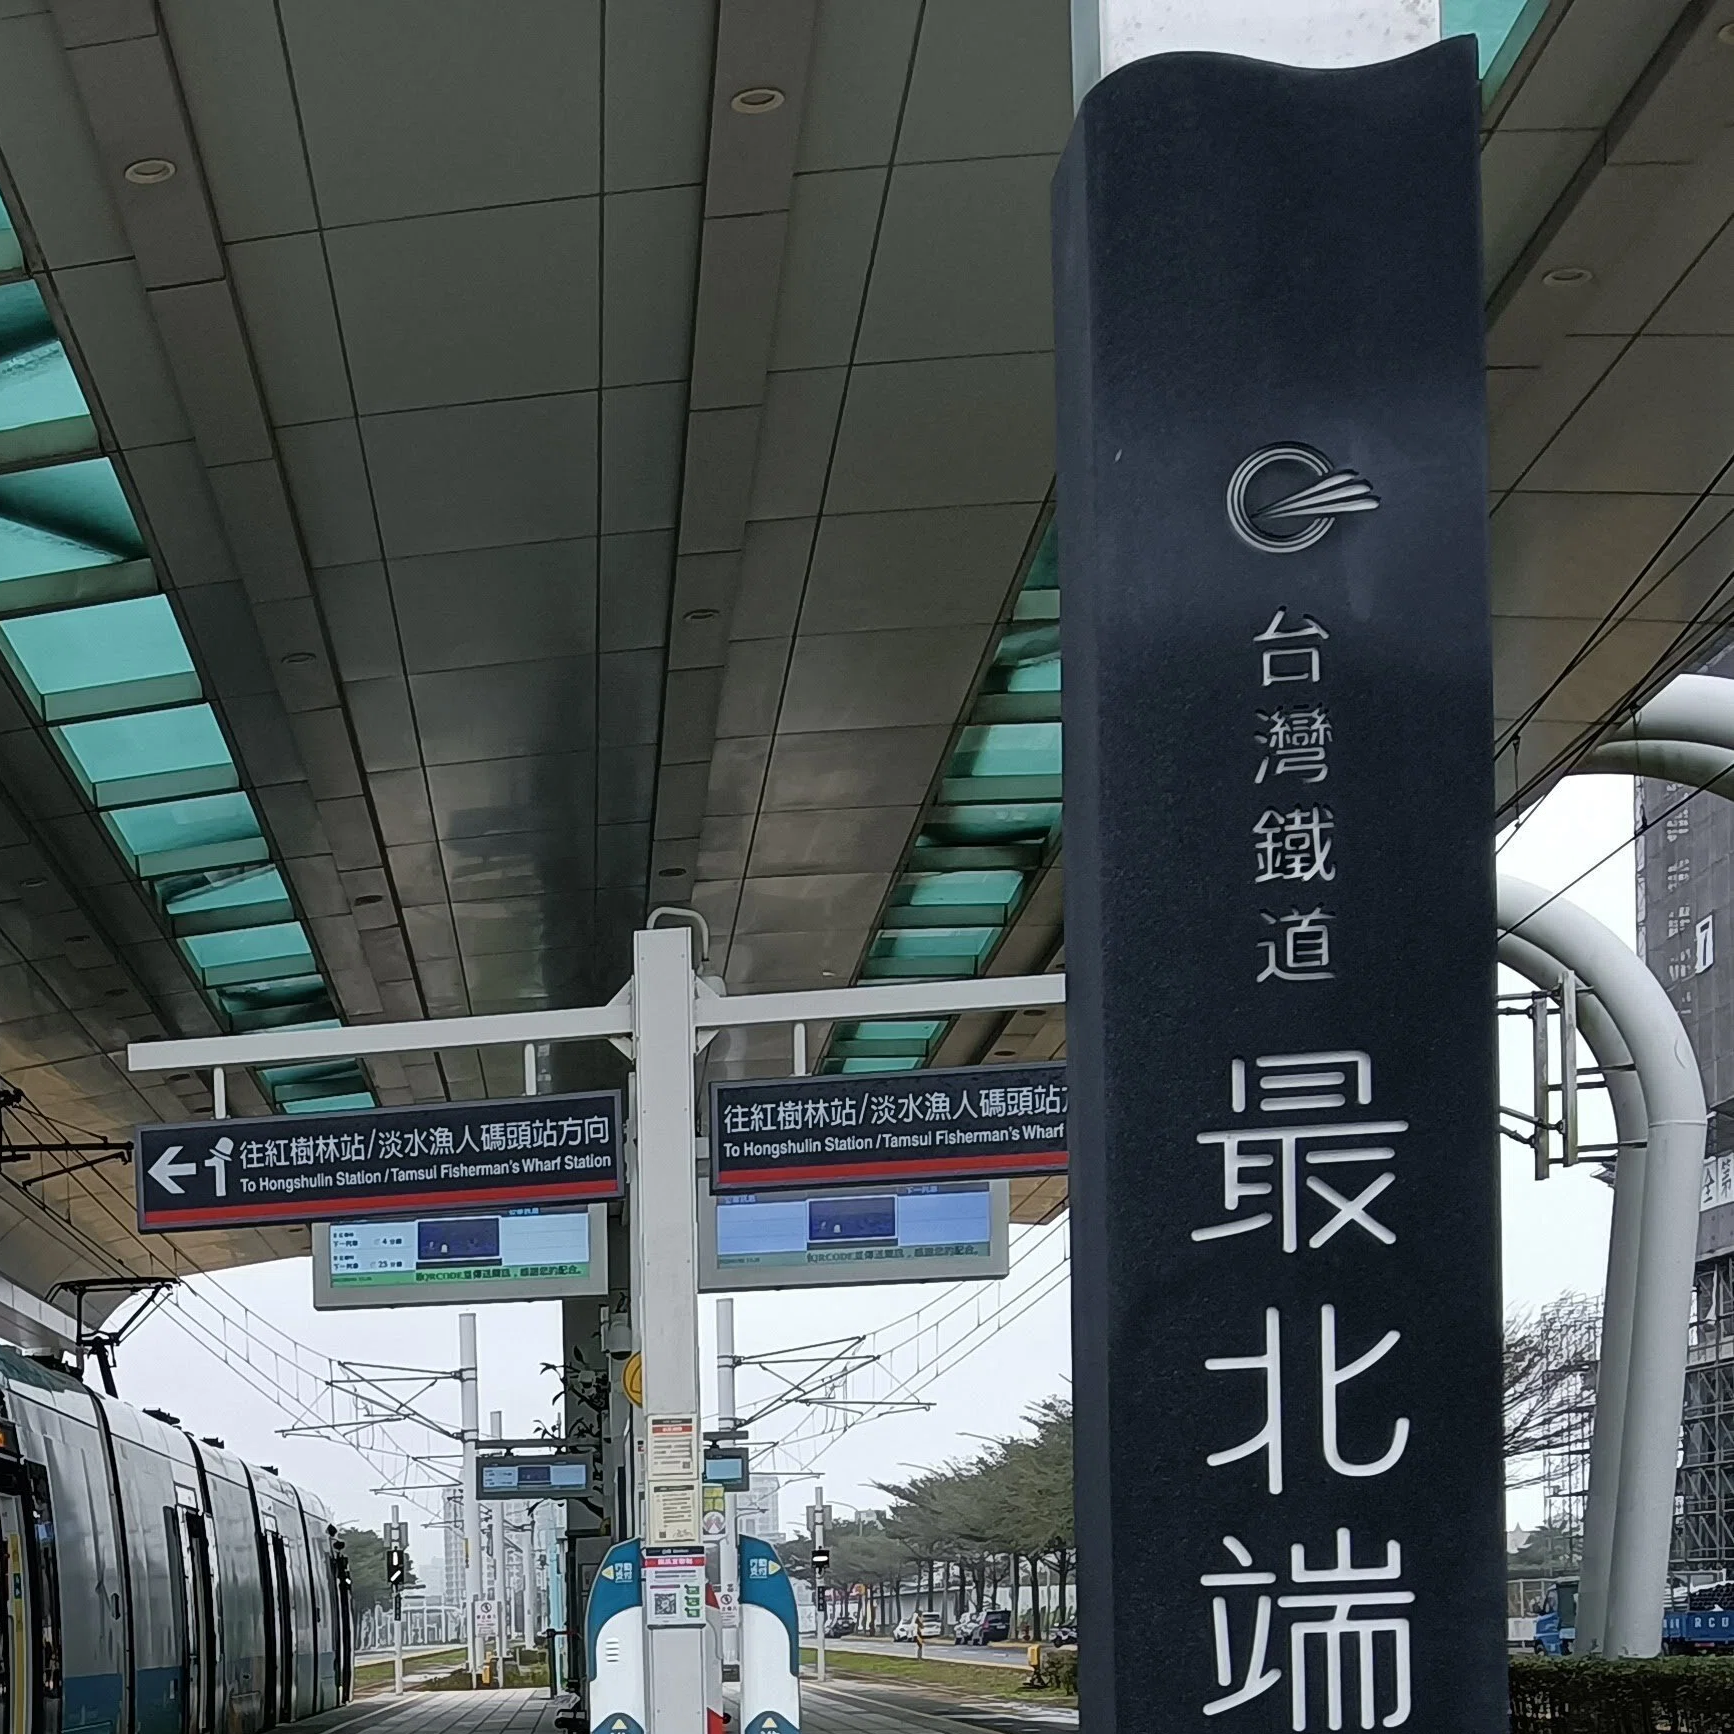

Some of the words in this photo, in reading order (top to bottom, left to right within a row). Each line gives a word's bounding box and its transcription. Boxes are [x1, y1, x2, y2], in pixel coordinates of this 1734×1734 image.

[1254, 606, 1336, 984] 台灣鐵道
[723, 1084, 1068, 1134] 往紅樹林站/淡水漁人碼頭站
[239, 1115, 609, 1170] 往紅樹林站/淡水漁人碼頭站方向
[723, 1142, 740, 1158] To
[743, 1138, 822, 1159] Hongshulin
[824, 1135, 873, 1152] Station
[935, 1126, 1020, 1145] Fisherman's
[1022, 1123, 1065, 1140] Wharf
[239, 1178, 257, 1193] To
[259, 1173, 333, 1193] Hongshulin
[336, 1170, 382, 1186] Station
[440, 1159, 520, 1179] Fisherman's
[521, 1156, 562, 1173] Wharf
[564, 1153, 612, 1170] Station
